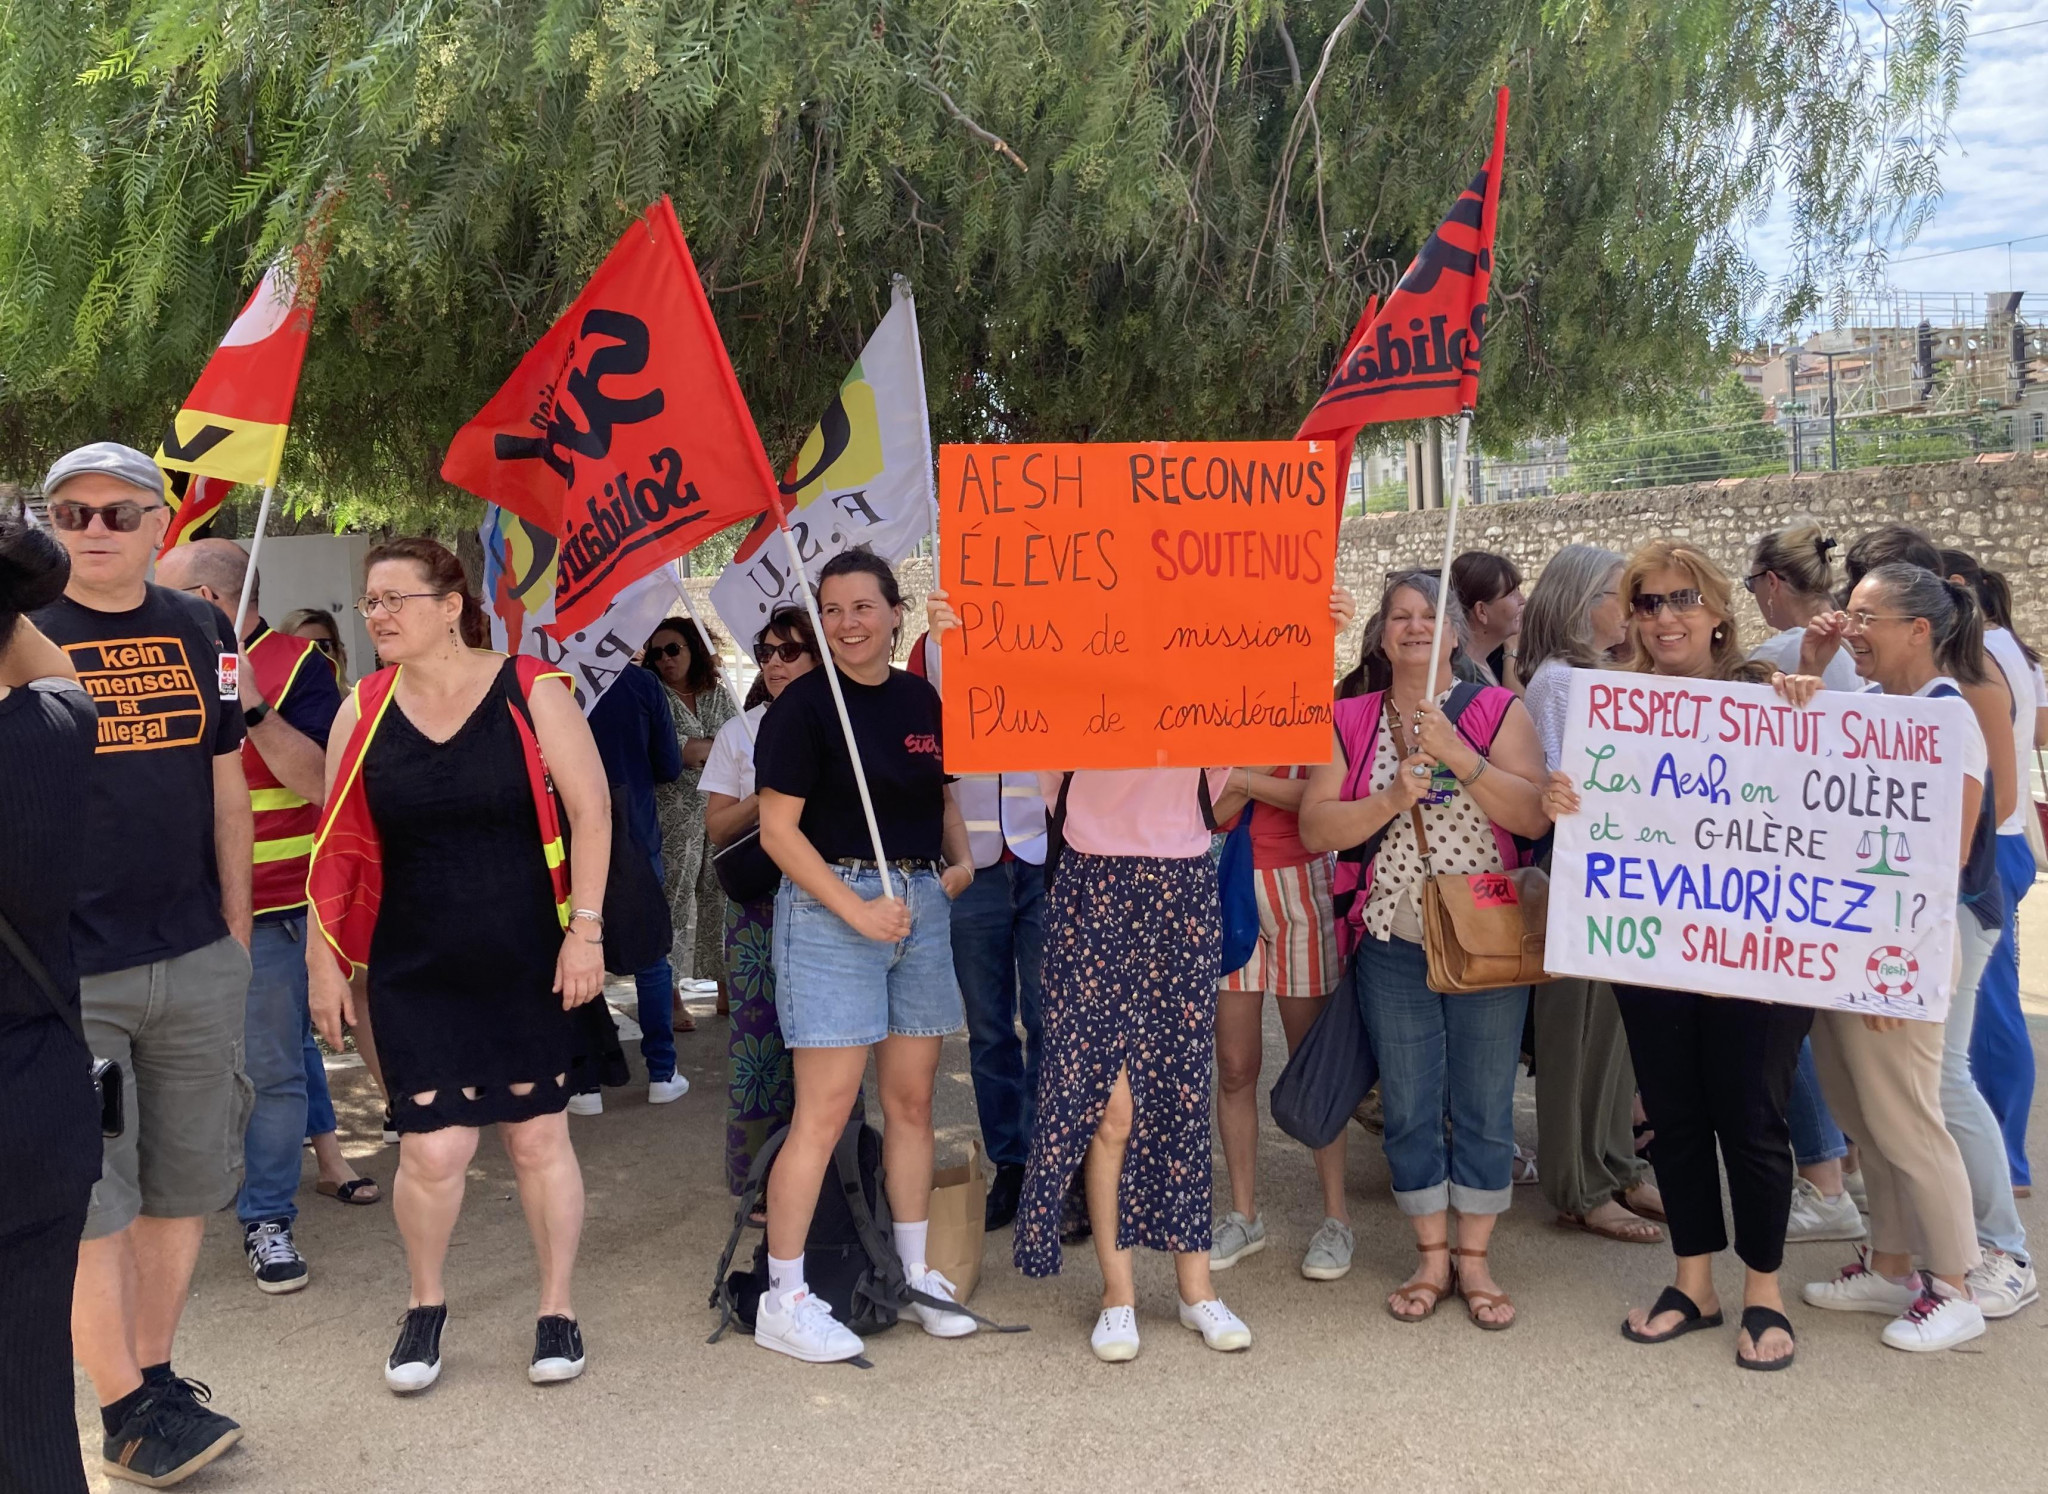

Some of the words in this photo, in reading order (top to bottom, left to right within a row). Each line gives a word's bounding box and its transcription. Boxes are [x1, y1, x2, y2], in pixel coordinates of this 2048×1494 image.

[958, 453, 1083, 515] AESH
[1129, 453, 1326, 506] RECONNUS
[959, 521, 1119, 591] ÉLÈVES
[1150, 529, 1323, 585] SOUTENUS
[960, 601, 1063, 656] Plus
[1082, 613, 1129, 656] de
[1163, 619, 1312, 651] missions
[98, 643, 166, 669] kein
[84, 670, 190, 695] mensch
[98, 717, 168, 745] illegal
[968, 685, 1049, 740] Plus
[1083, 693, 1126, 736] de
[1154, 681, 1334, 732] considérations
[1583, 743, 1641, 793] Les
[1650, 752, 1731, 805] Aesh
[1741, 782, 1780, 803] en
[1802, 765, 1931, 822] COLÈRE
[1590, 812, 1623, 841] et
[1635, 826, 1676, 845] en
[1694, 811, 1828, 861] GALÈRE
[1587, 915, 1662, 959] NOS
